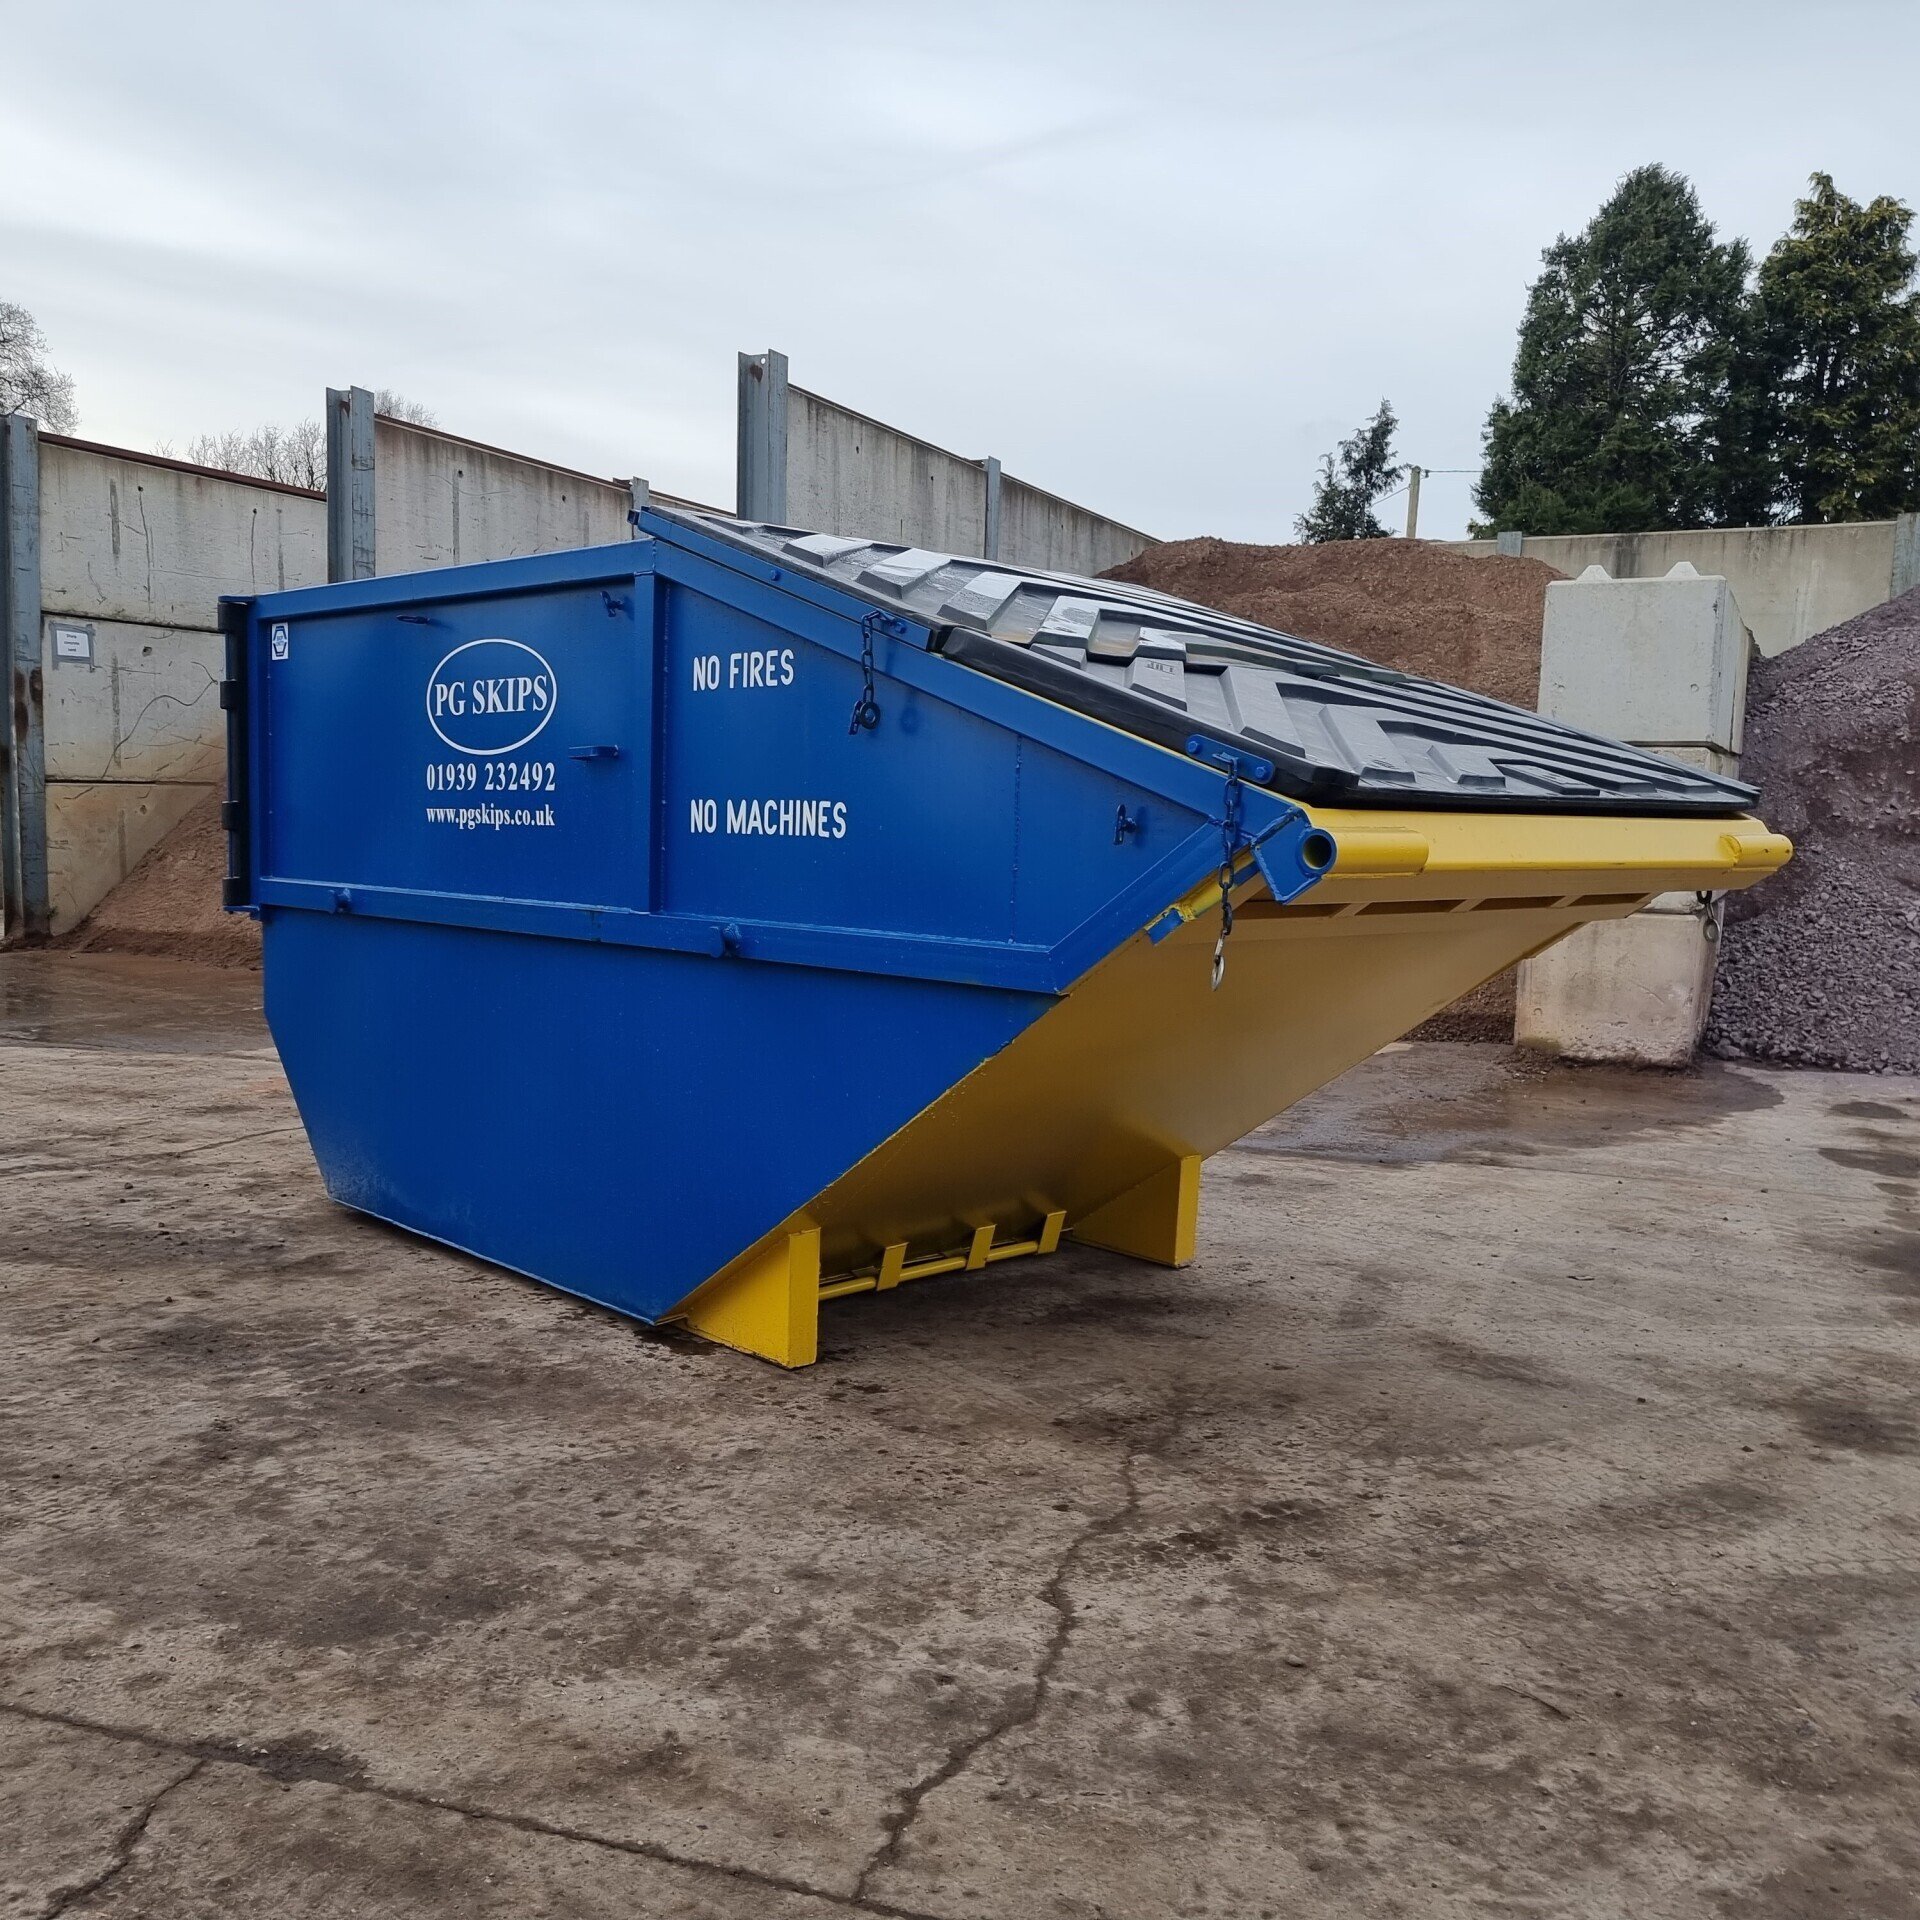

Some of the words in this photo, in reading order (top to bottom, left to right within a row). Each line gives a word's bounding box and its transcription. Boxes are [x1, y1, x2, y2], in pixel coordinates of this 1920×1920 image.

[693, 656, 720, 691] NO
[730, 649, 794, 688] FIRES
[435, 681, 466, 716] PG
[473, 675, 548, 714] SKIPS
[426, 763, 477, 791] 01939
[484, 762, 556, 791] 232492
[426, 803, 555, 830] www.pgskips.co.uk
[690, 799, 717, 833] NO
[726, 799, 847, 839] MACHINES
